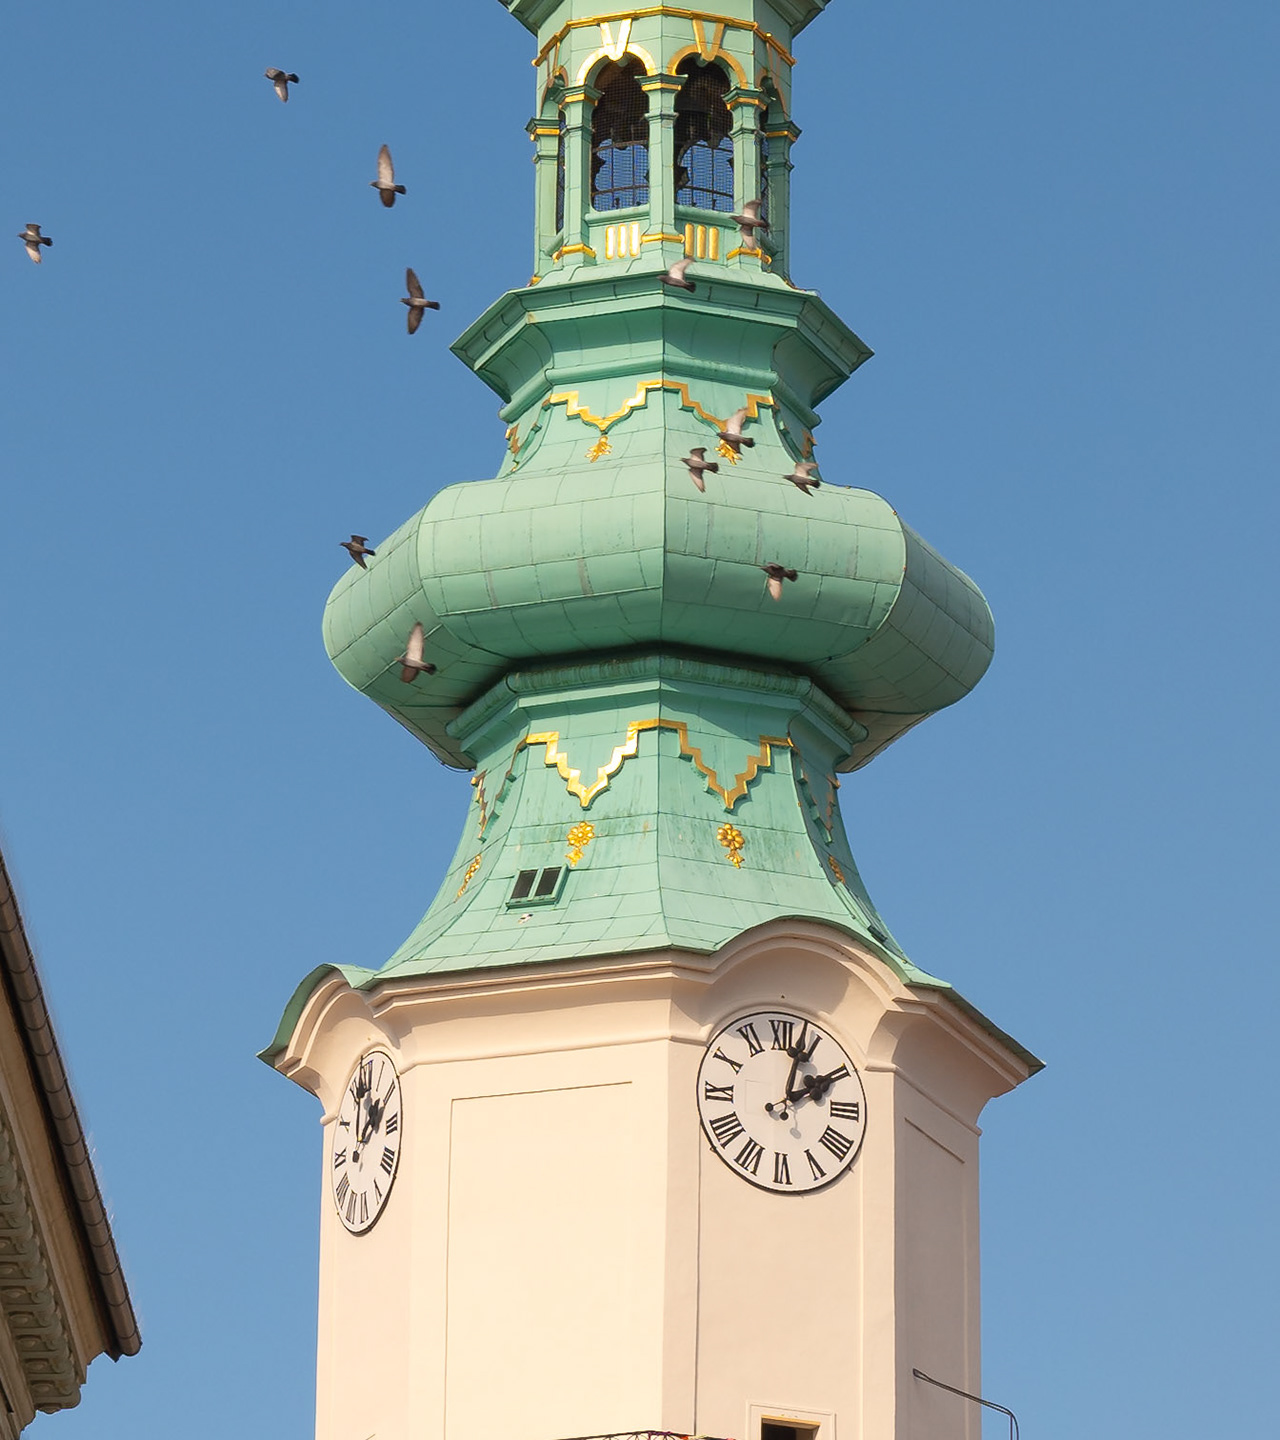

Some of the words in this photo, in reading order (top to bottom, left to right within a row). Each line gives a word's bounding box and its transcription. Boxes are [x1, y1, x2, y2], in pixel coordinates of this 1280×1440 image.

[736, 1022, 765, 1057] XI
[768, 1020, 795, 1051] XII
[712, 1046, 744, 1075] X
[830, 1100, 859, 1123] III
